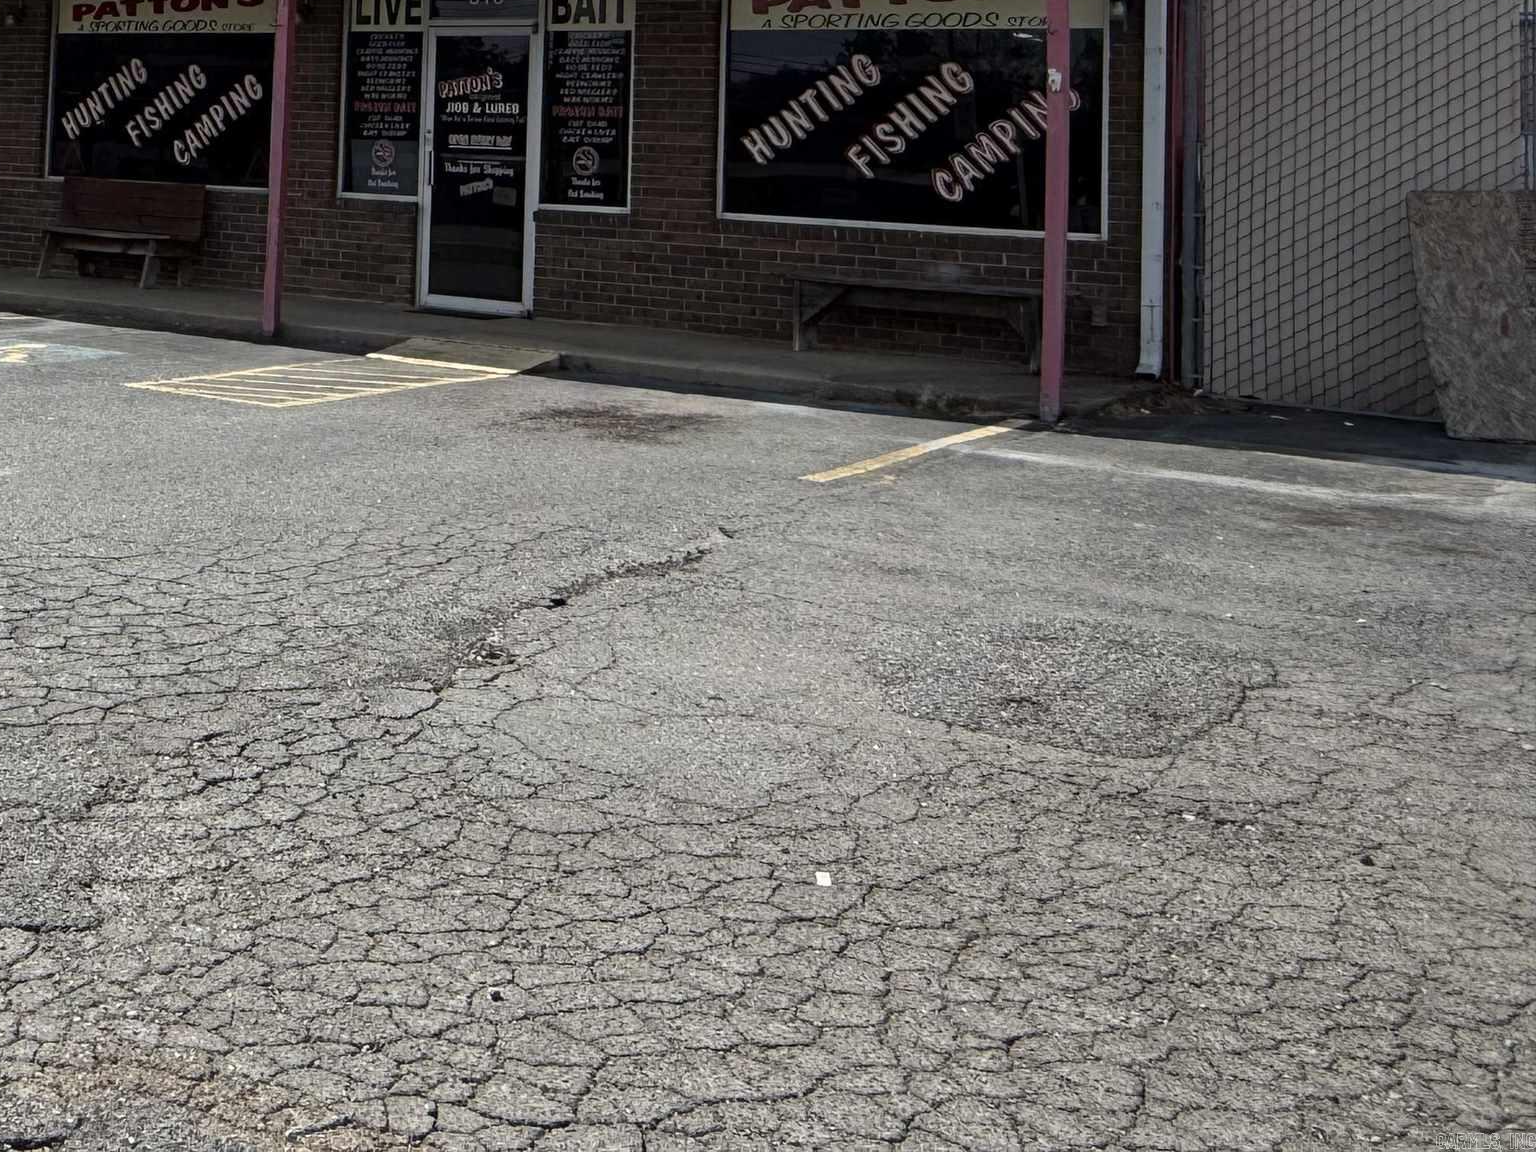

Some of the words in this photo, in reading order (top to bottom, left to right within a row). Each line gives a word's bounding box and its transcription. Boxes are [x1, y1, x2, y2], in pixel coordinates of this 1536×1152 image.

[90, 20, 158, 33] SPORTING
[162, 19, 218, 32] GOODS
[781, 13, 899, 29] SPORTING
[905, 12, 1000, 29] GOODS
[61, 57, 149, 141] HUNTING
[126, 64, 208, 149] FISHING
[172, 74, 264, 167] CAMPING
[472, 101, 482, 114] &
[740, 54, 881, 166] HUNTING
[846, 62, 974, 179] FISHING
